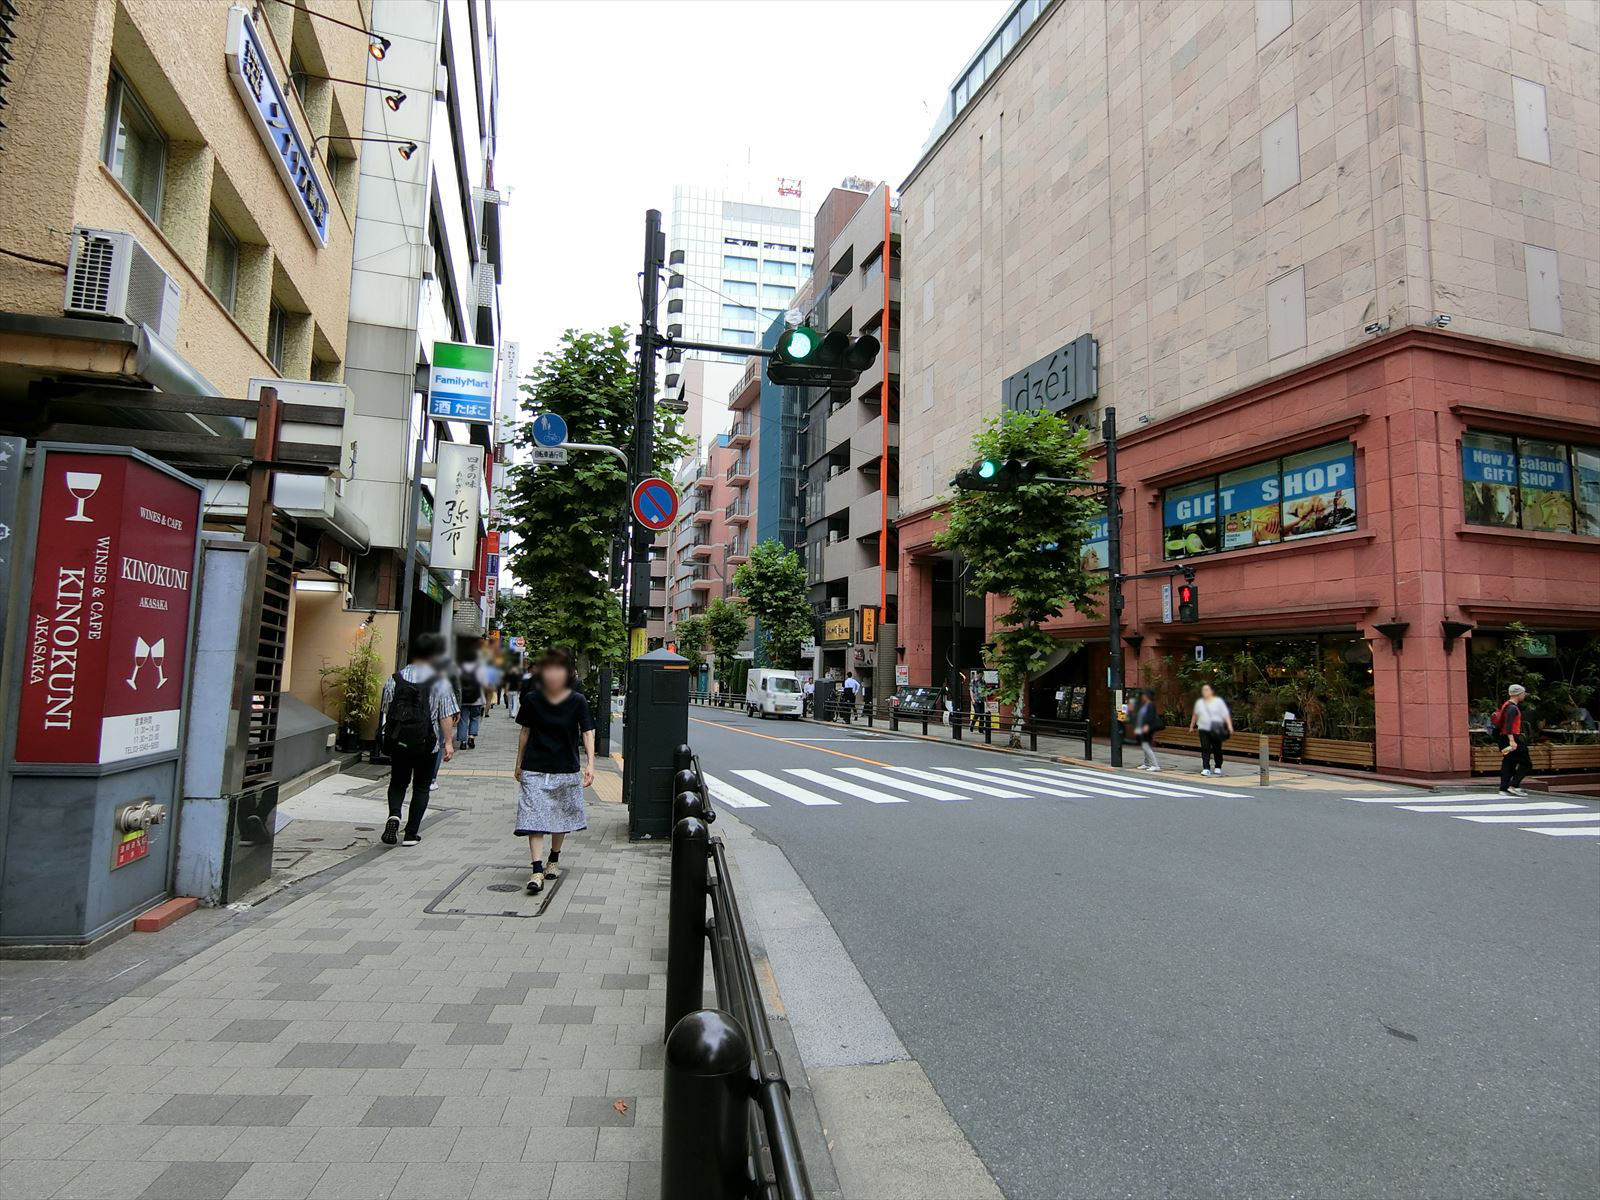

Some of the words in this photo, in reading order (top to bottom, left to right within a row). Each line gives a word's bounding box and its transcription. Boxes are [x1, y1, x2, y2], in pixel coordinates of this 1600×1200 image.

[435, 374, 489, 389] FamilyMart
[434, 400, 451, 414] 酒
[455, 402, 487, 416] たばこ
[1473, 449, 1502, 467] New
[1483, 466, 1514, 483] GIFT
[1521, 472, 1555, 487] SHOP
[1176, 489, 1236, 521] GIFT
[1261, 462, 1347, 502] SHOP
[140, 506, 161, 524] WINES
[167, 517, 183, 531] CAFE
[94, 536, 110, 583] WINES
[121, 556, 189, 590] KINOKUNI
[92, 587, 105, 598] &
[138, 597, 168, 610] AKASAKA
[88, 601, 104, 640] CAFE
[30, 614, 50, 684] AKASAKA
[44, 566, 86, 730] KINOKUNI
